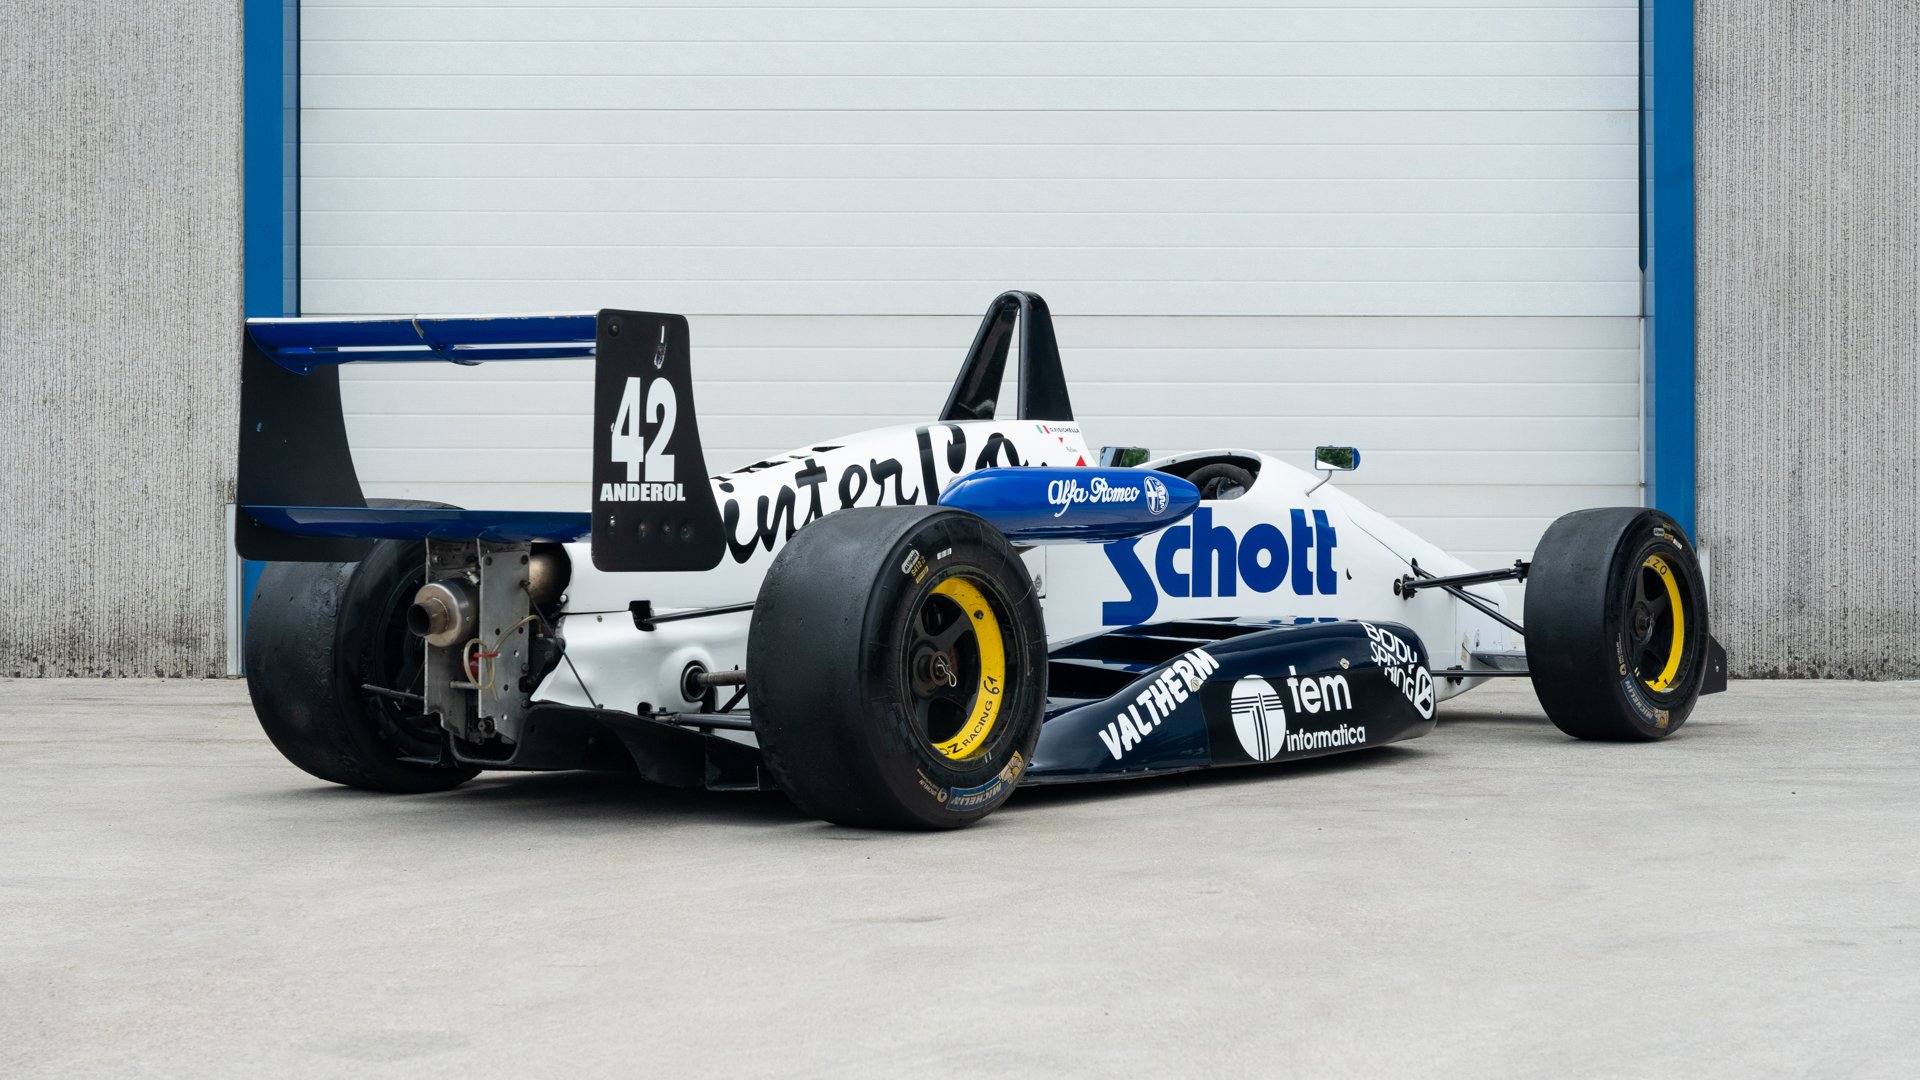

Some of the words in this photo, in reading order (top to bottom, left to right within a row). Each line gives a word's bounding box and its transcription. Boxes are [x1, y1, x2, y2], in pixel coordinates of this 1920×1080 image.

[611, 376, 677, 483] 42
[600, 483, 686, 502] ANDEROL
[1048, 479, 1089, 518] Alfa
[1089, 477, 1140, 503] Romeo
[1102, 507, 1337, 626] Schott
[1098, 648, 1220, 760] VALTHERM
[1288, 665, 1352, 714] tem
[1625, 680, 1654, 719] MICHELIN
[962, 700, 993, 746] RACING
[1286, 724, 1366, 752] informatica
[951, 783, 1001, 806] MICHELIN
